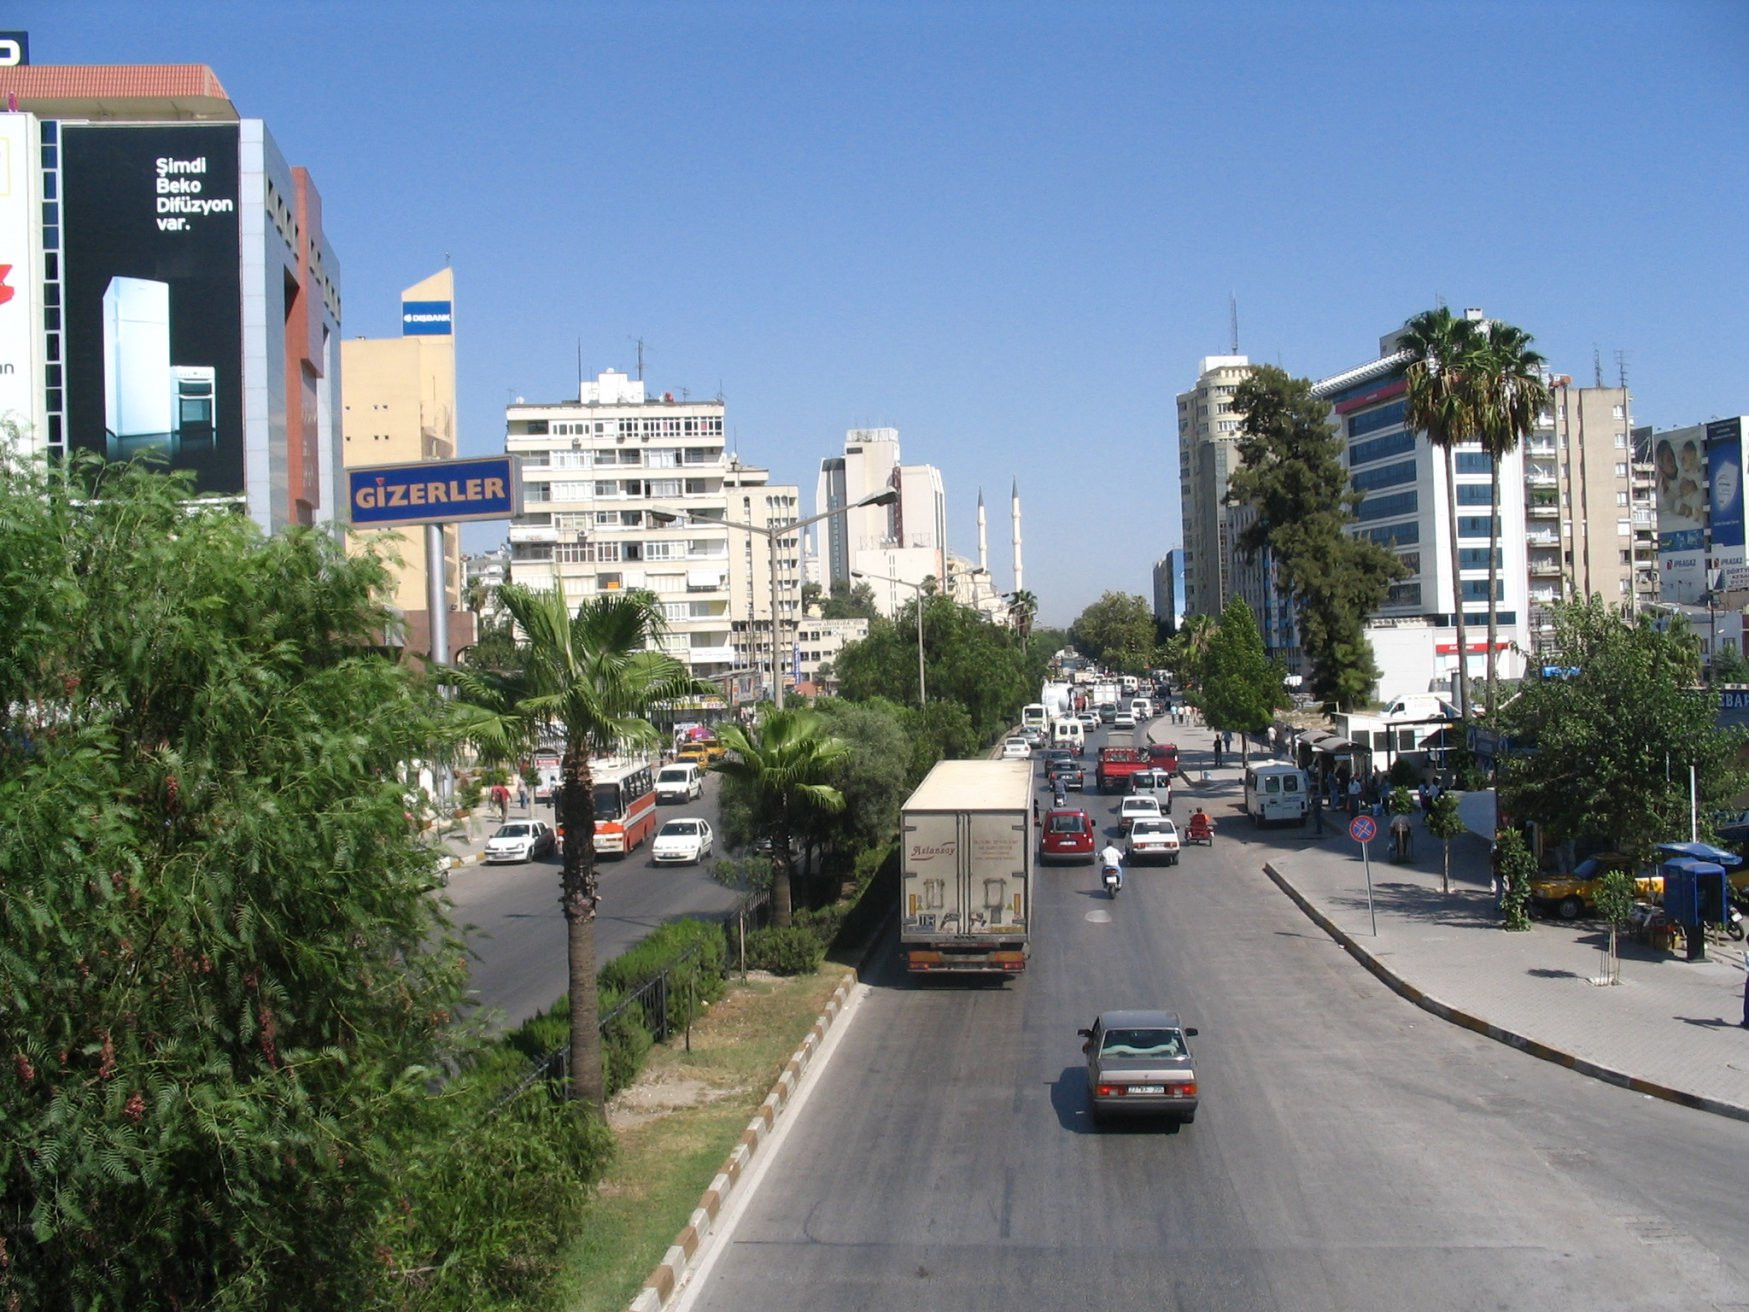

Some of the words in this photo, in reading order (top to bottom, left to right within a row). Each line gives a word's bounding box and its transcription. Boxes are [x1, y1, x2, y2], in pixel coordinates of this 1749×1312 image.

[156, 157, 206, 177] Şimdi
[156, 178, 202, 193] Beko
[157, 196, 233, 215] Difüzyon
[156, 218, 191, 231] var.
[355, 477, 505, 509] GİZERLER
